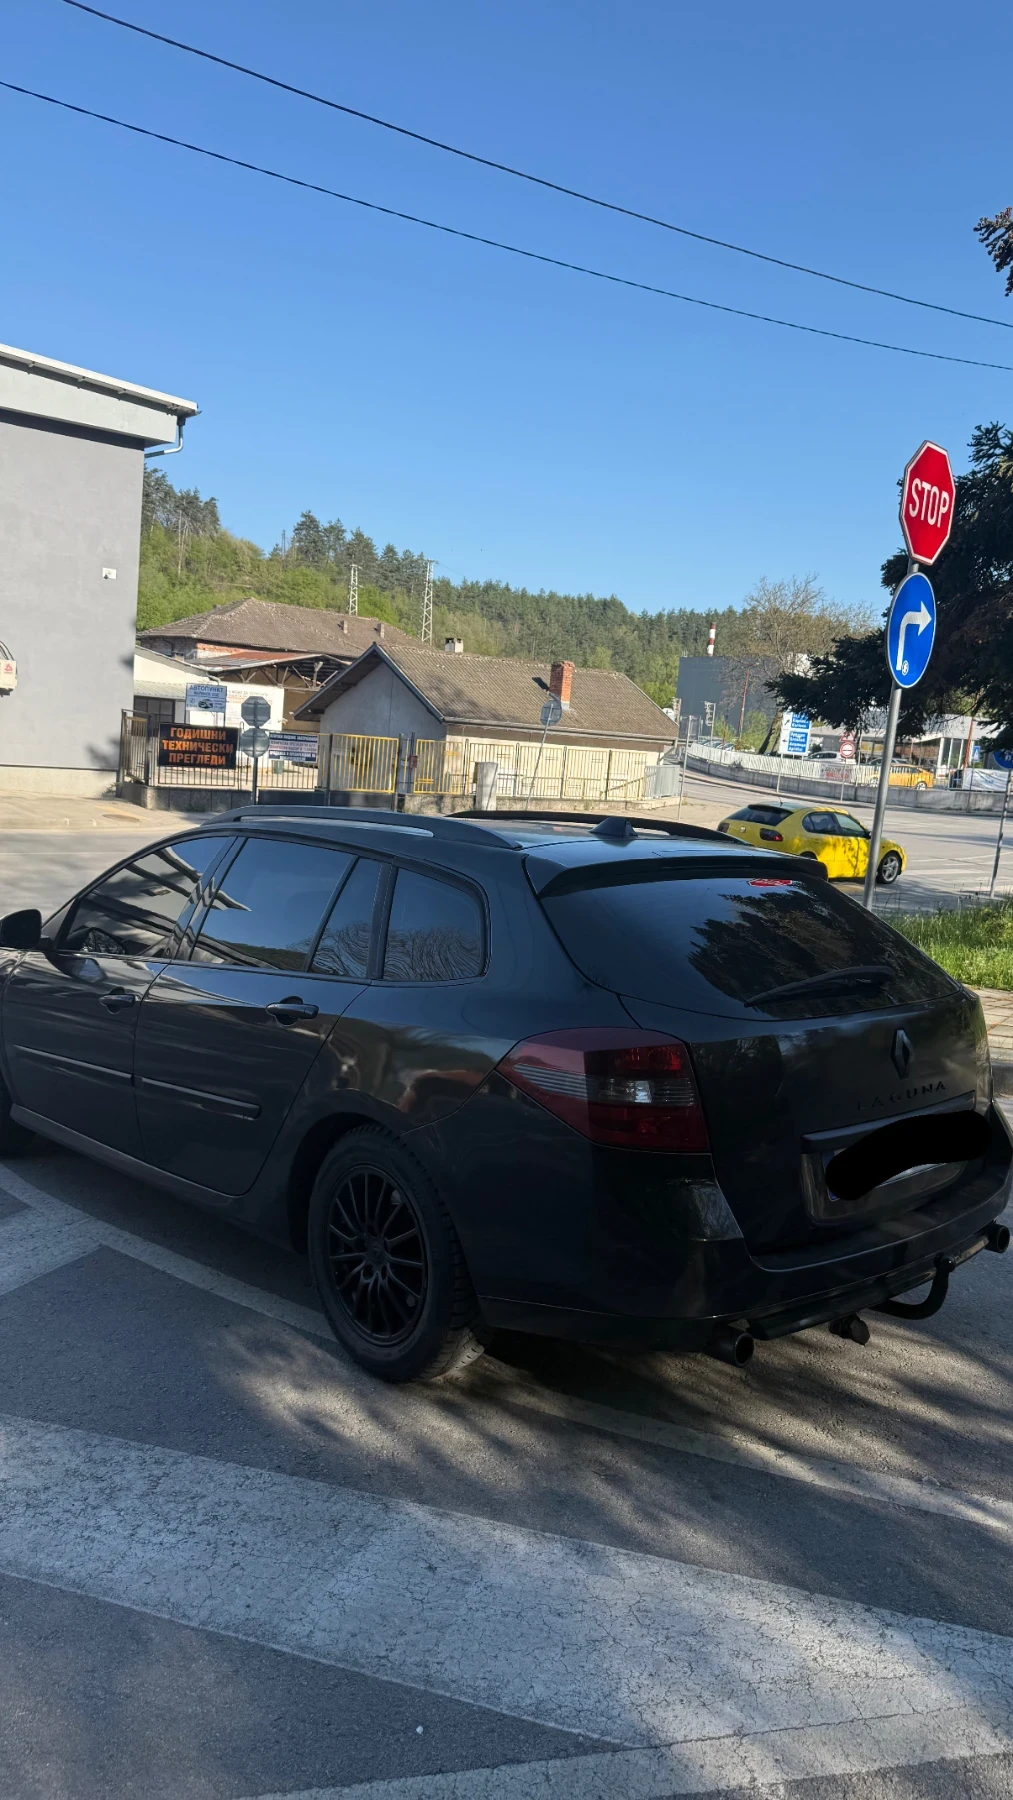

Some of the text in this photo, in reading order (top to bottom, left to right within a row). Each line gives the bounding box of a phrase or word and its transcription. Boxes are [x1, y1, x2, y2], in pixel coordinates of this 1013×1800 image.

[909, 478, 950, 528] STOP
[189, 685, 224, 693] АВТОПУНКТ
[170, 727, 226, 740] ГОДИШНИ
[162, 740, 234, 753] ТЕХНИЧЕСКИ
[169, 753, 226, 765] ПРЕГЛЕДИ
[857, 1081, 946, 1111] LAGUNA
